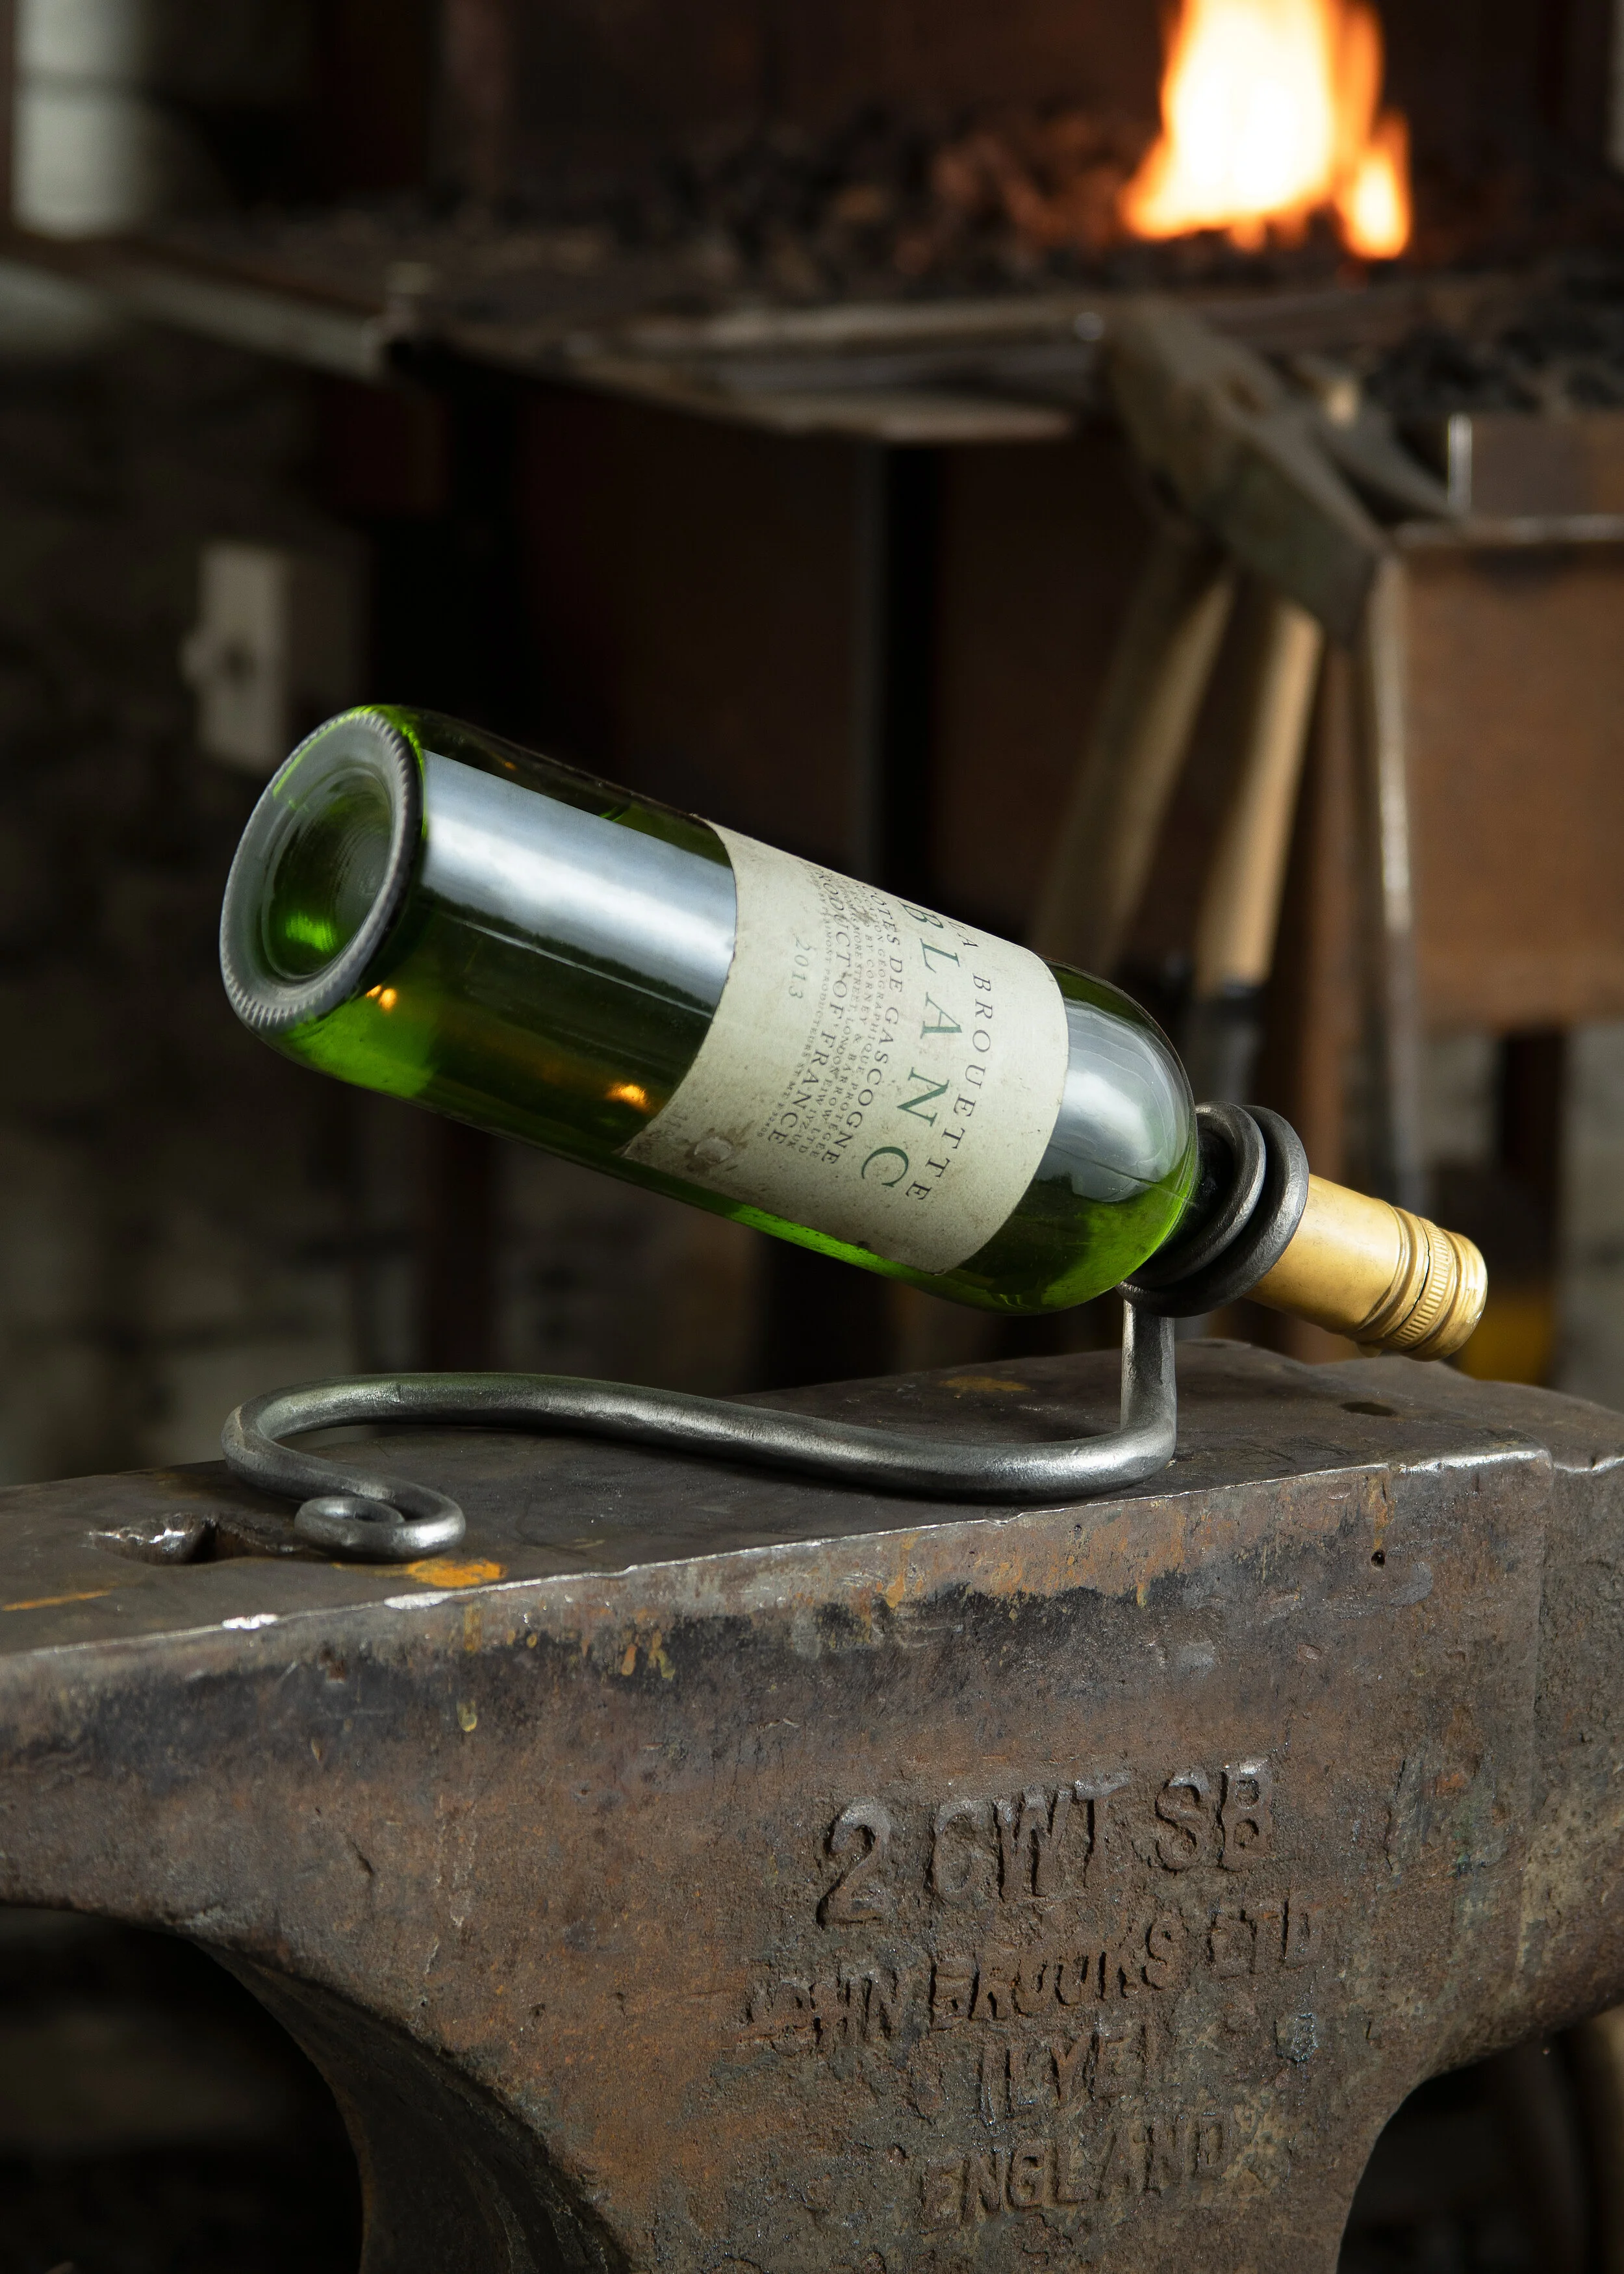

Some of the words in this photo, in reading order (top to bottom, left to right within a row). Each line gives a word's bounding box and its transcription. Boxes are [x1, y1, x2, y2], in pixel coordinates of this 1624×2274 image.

[947, 920, 979, 948] LA
[788, 935, 811, 999] 2013
[829, 979, 848, 1019] OF
[859, 958, 874, 1025] CORNEY
[889, 955, 903, 993] DE
[829, 1017, 854, 1074] LONDON
[852, 1033, 863, 1043] &
[861, 900, 963, 1188] BLANC
[768, 1030, 837, 1144] FRANCE
[821, 1006, 899, 1164] GASCOGNE
[821, 1053, 858, 1121] BARROW
[905, 972, 993, 1201] BROUETTE
[798, 1127, 821, 1153] LTD
[816, 1797, 894, 1930] 2
